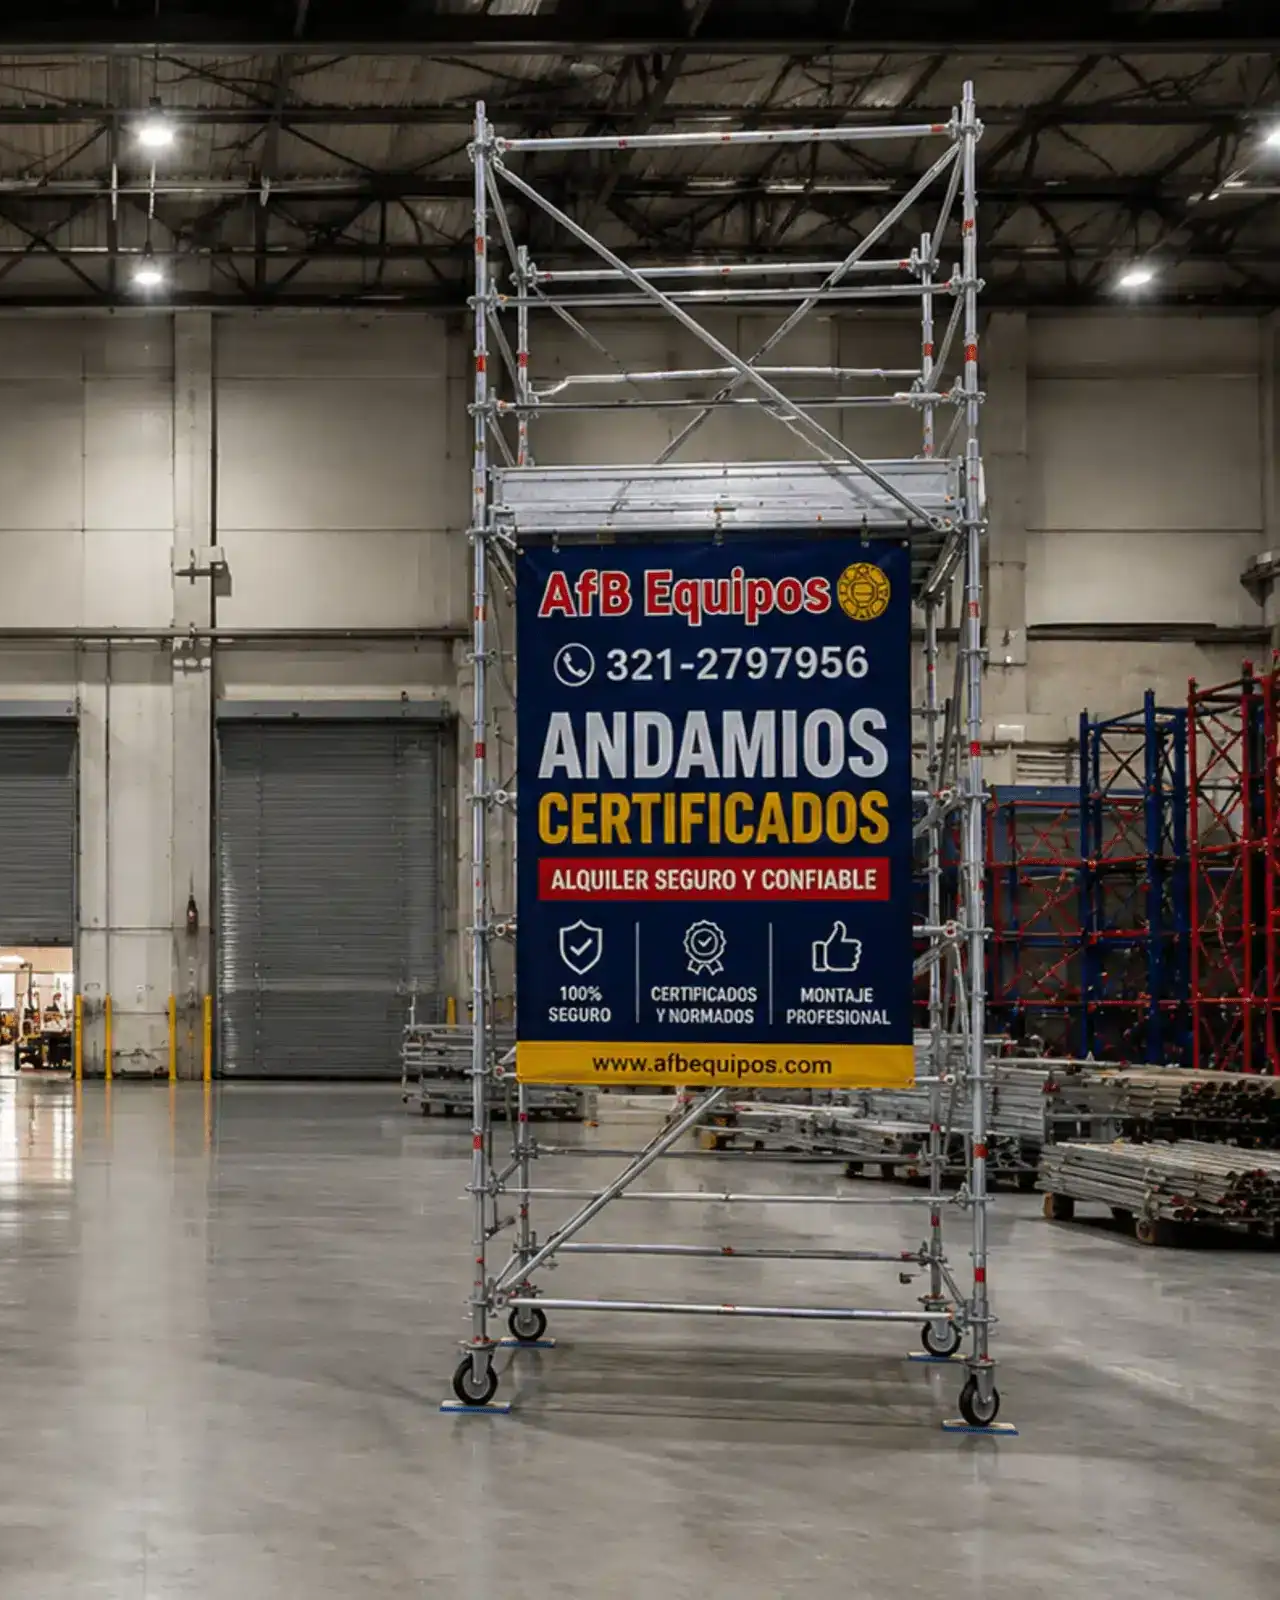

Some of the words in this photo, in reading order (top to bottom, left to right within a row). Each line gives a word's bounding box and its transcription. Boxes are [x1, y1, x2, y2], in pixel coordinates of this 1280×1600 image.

[537, 568, 633, 618] AfB
[643, 566, 832, 627] Equipos
[606, 645, 869, 681] 321-2797956
[538, 707, 889, 779] ANDAMIOS
[538, 790, 889, 845] CERTIFICADOS
[551, 869, 649, 891] ALQUILER
[654, 869, 736, 890] SEGURO
[741, 869, 756, 890] Y
[761, 869, 877, 891] CONFIABLE
[560, 985, 603, 1002] 100%
[651, 986, 758, 1003] CERTIFICADOS
[800, 987, 873, 1003] MONTAJE
[548, 1006, 612, 1023] SEGURO
[656, 1008, 667, 1023] Y
[669, 1008, 754, 1024] NORMADOS
[786, 1009, 891, 1025] PROFESIONAL
[592, 1052, 833, 1080] www.afbequipos.com
